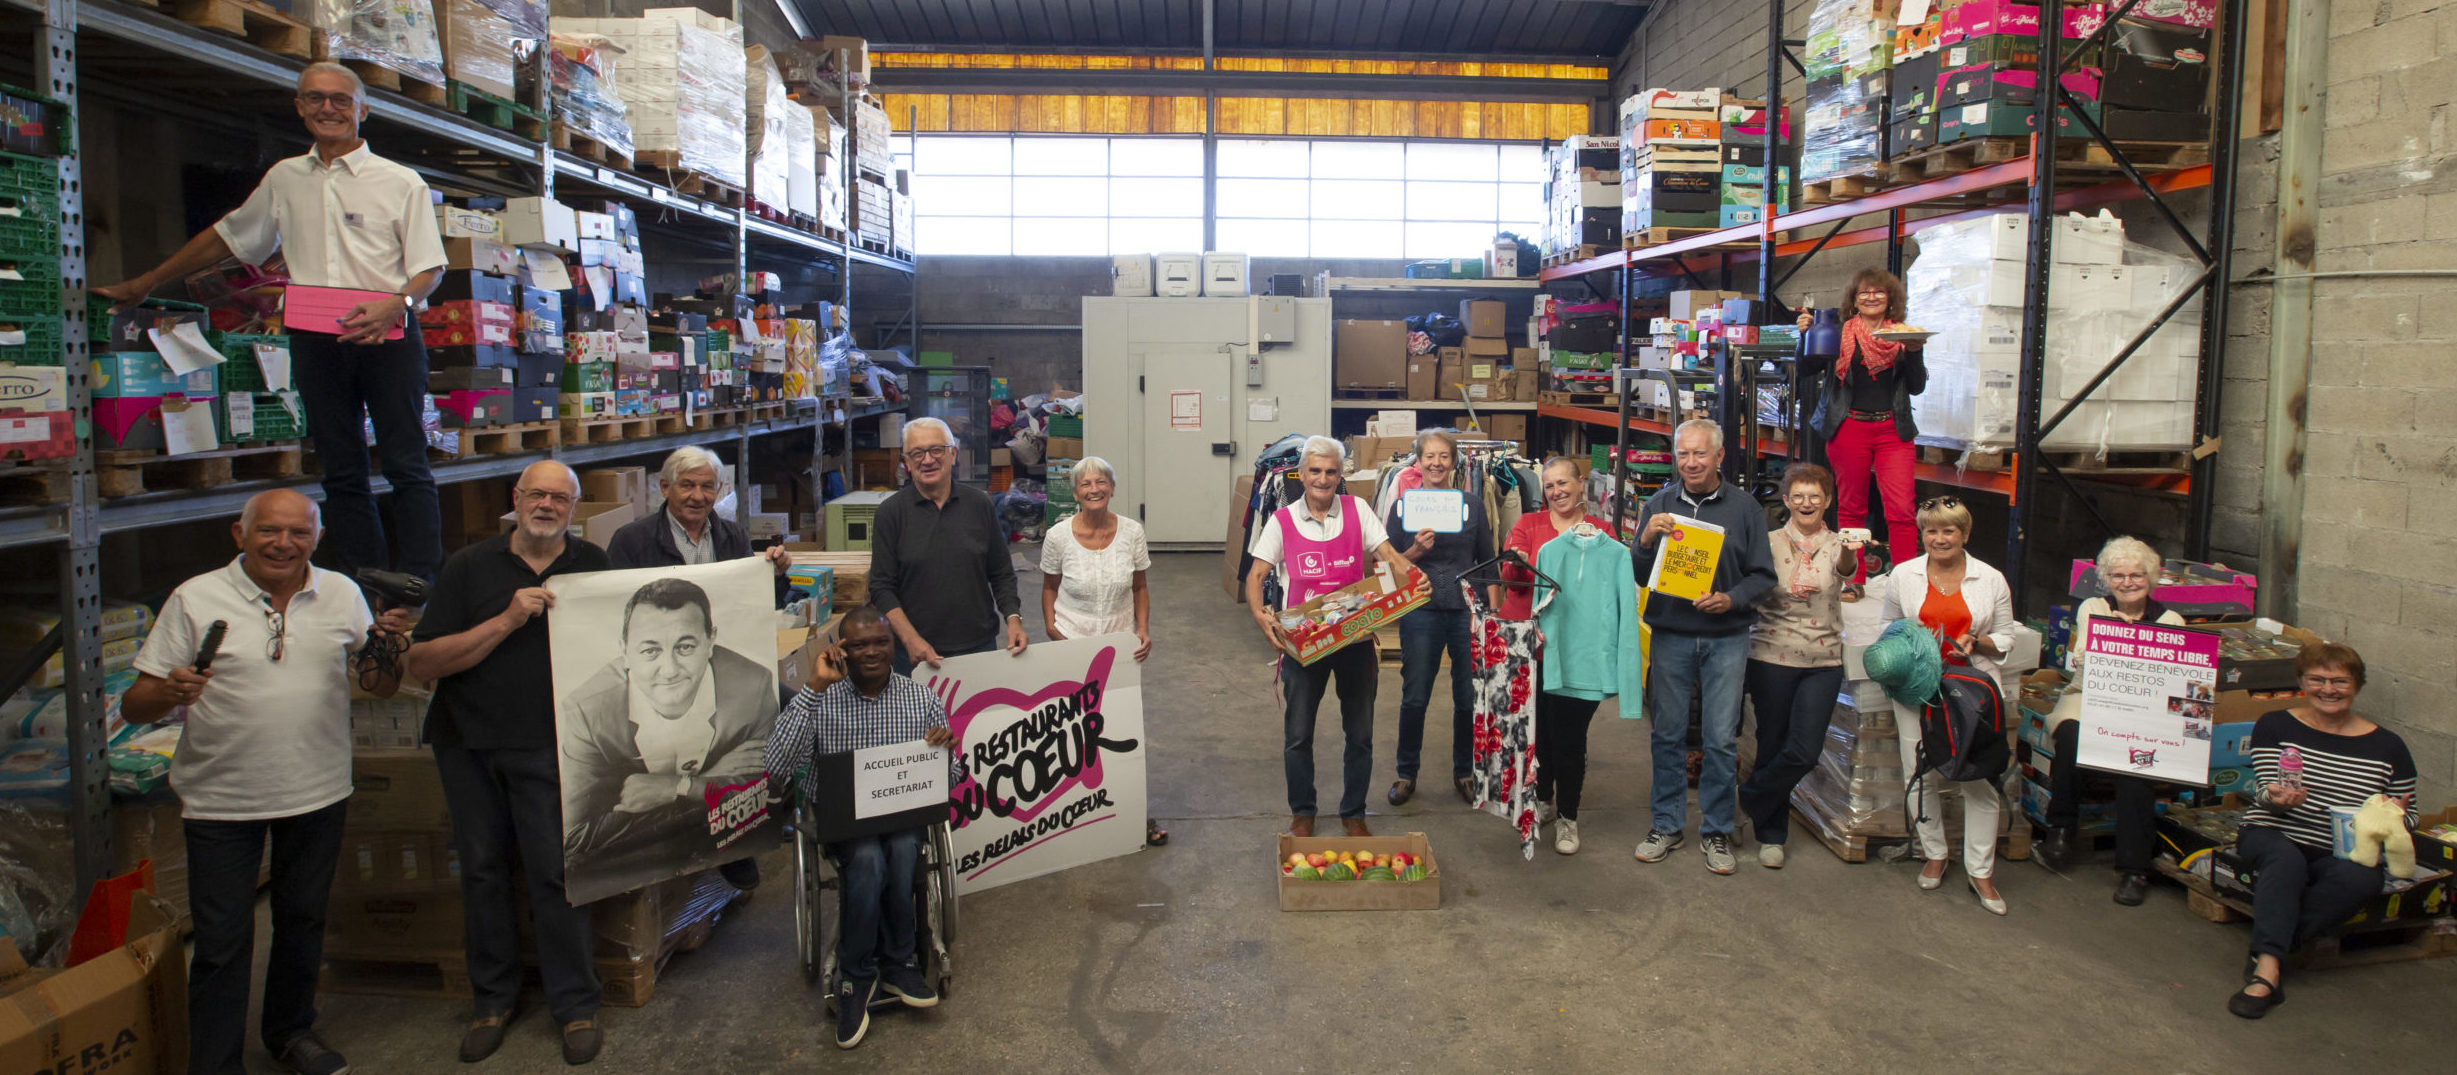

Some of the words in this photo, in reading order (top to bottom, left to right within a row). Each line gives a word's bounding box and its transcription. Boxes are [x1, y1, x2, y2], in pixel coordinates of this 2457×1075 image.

[2070, 14, 2102, 30] Pink
[1586, 140, 1599, 148] San
[0, 385, 34, 396] rro
[2092, 623, 2136, 639] DONNEZ
[2139, 629, 2153, 641] DU
[2156, 631, 2186, 646] SENS
[2091, 636, 2098, 651] À
[2101, 640, 2135, 655] VOTRE
[2138, 645, 2175, 661] TEMPS
[2178, 651, 2213, 667] LIBRE,
[2088, 668, 2113, 679] AUX
[2117, 671, 2165, 686] RESTOS
[2089, 655, 2145, 671] DEVENEZ
[2148, 661, 2214, 681] BÉNÉVOLE
[2088, 680, 2105, 690] DU
[2109, 683, 2151, 697] COEUR
[974, 680, 1100, 775] RESTAURANTS
[2097, 727, 2109, 736] On
[2111, 731, 2142, 742] compte
[2161, 739, 2180, 747] vous
[864, 757, 904, 771] ACCUEIL
[906, 751, 939, 764] PUBLIC
[897, 770, 908, 780] ET
[871, 780, 933, 799] SECRETARIAT
[710, 817, 726, 835] DU
[955, 850, 981, 875] LES
[981, 823, 1036, 864] RELAIS
[1037, 811, 1060, 836] DU
[33, 1028, 138, 1075] FRA
